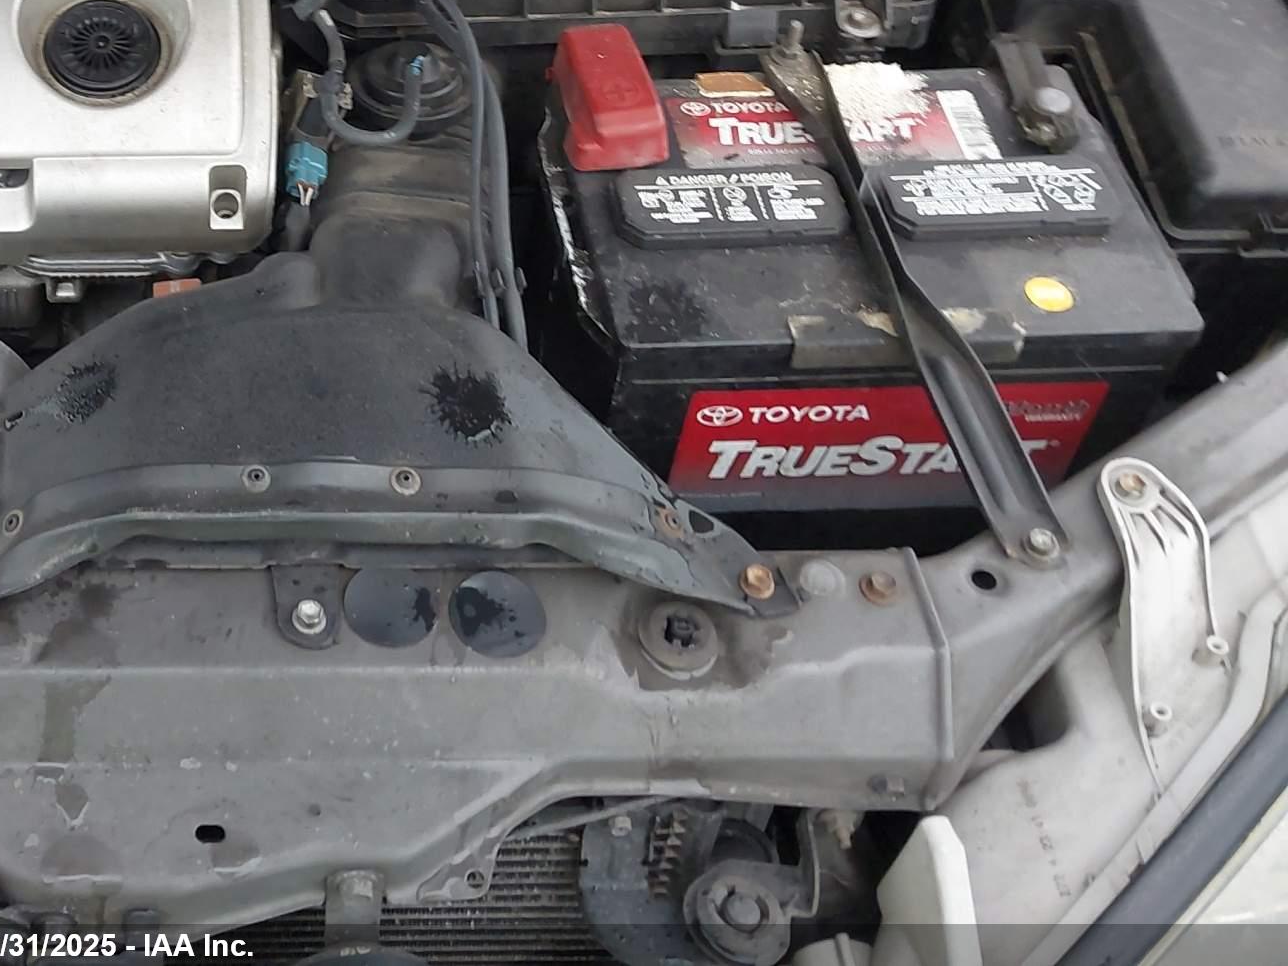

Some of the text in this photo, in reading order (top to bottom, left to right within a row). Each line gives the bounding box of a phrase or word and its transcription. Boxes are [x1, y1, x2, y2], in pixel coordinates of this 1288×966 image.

[711, 101, 790, 114] TOYOTA
[708, 117, 918, 146] TRUEART
[669, 174, 729, 185] DANGER
[739, 171, 794, 185] POISON
[749, 404, 871, 425] TOYOTA
[708, 435, 1047, 480] TRUESTA
